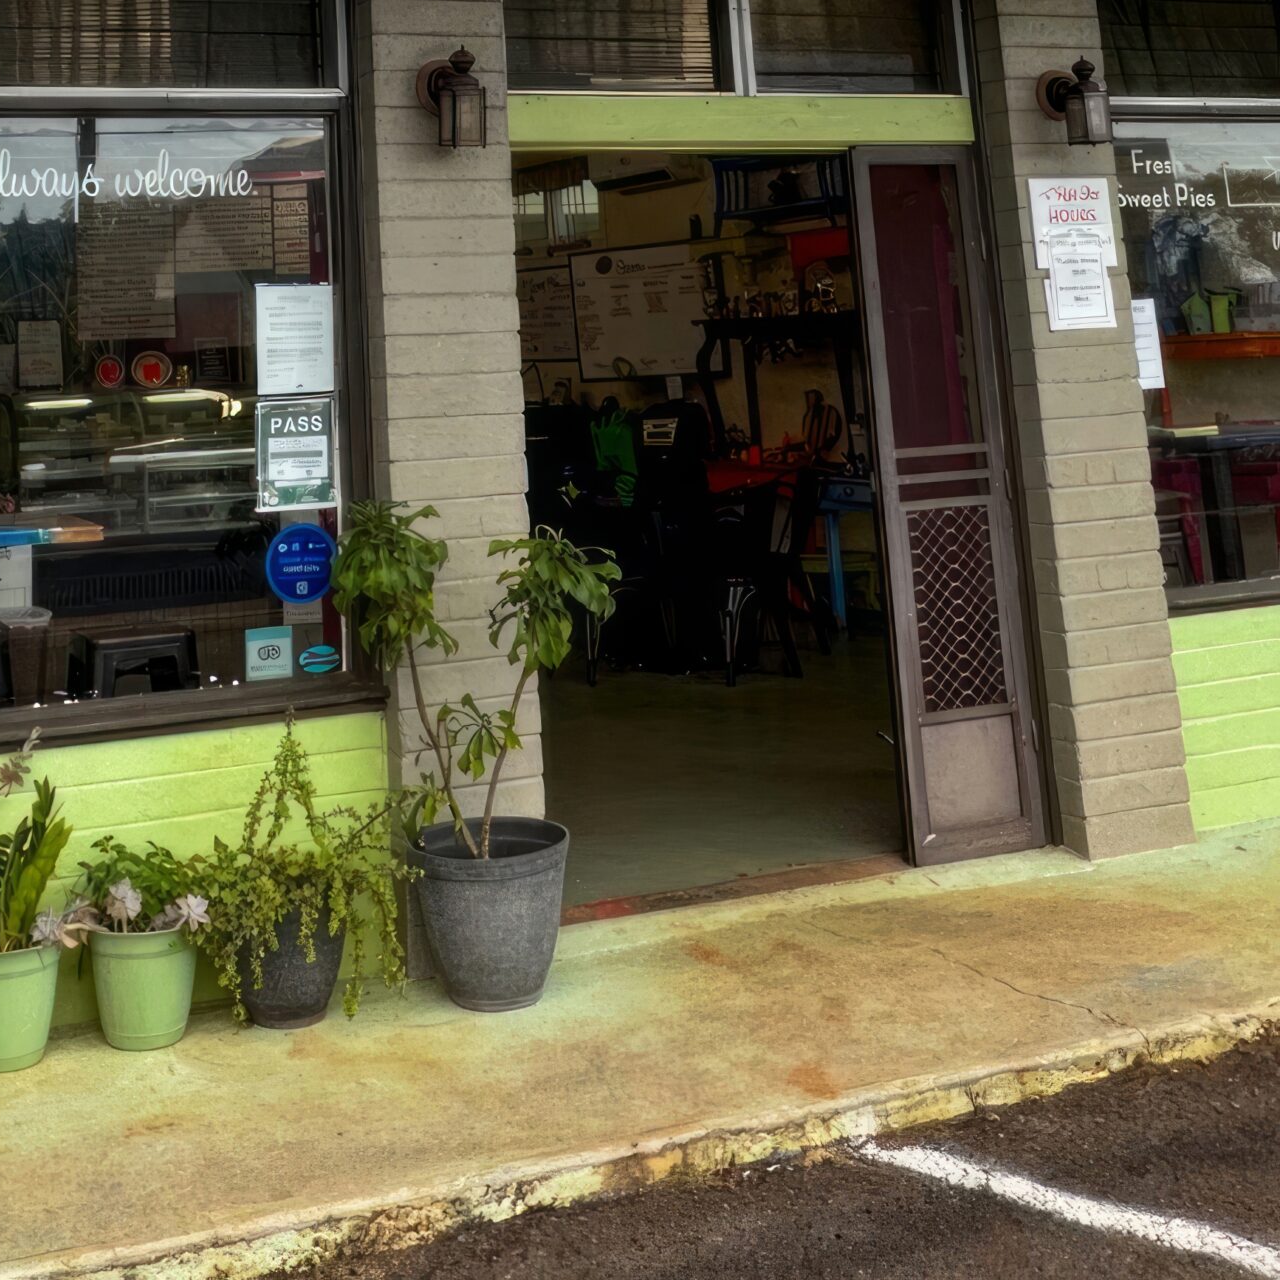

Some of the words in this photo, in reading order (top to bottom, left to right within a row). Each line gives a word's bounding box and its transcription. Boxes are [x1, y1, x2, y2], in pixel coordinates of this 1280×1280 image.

[1131, 149, 1183, 175] Fres
[1174, 183, 1217, 208] Pies
[270, 415, 323, 434] PASS
